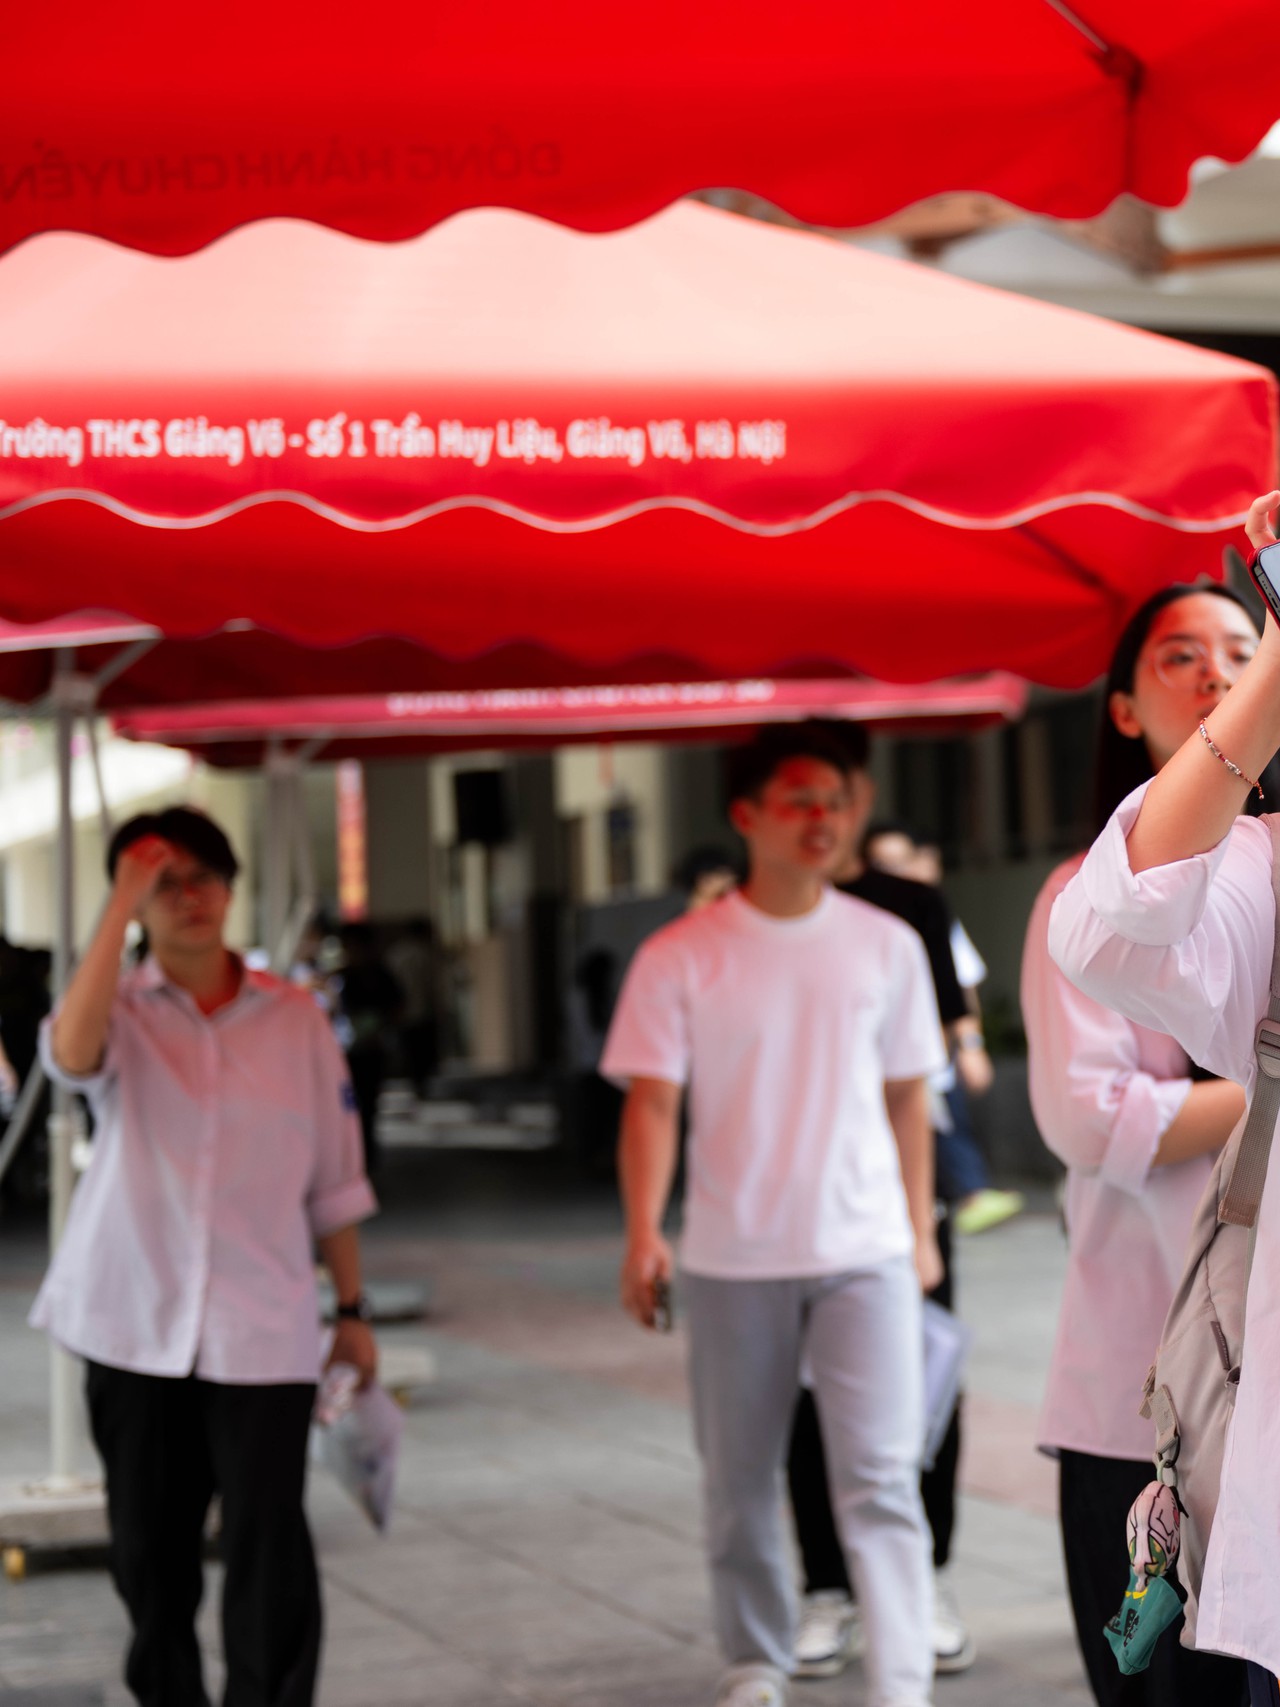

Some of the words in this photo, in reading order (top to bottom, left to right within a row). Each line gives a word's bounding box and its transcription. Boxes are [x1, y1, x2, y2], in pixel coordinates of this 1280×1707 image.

[87, 418, 161, 458] THCS
[164, 416, 244, 467] Giảng
[247, 417, 286, 458] Võ
[288, 433, 304, 448] -
[306, 411, 347, 458] Số
[347, 420, 367, 458] 1
[438, 418, 494, 467] Huy
[496, 417, 564, 465] Liệu,
[566, 416, 645, 467] Giảng
[647, 418, 693, 464] Võ,
[695, 418, 735, 459] Hà
[738, 418, 786, 465] Nội
